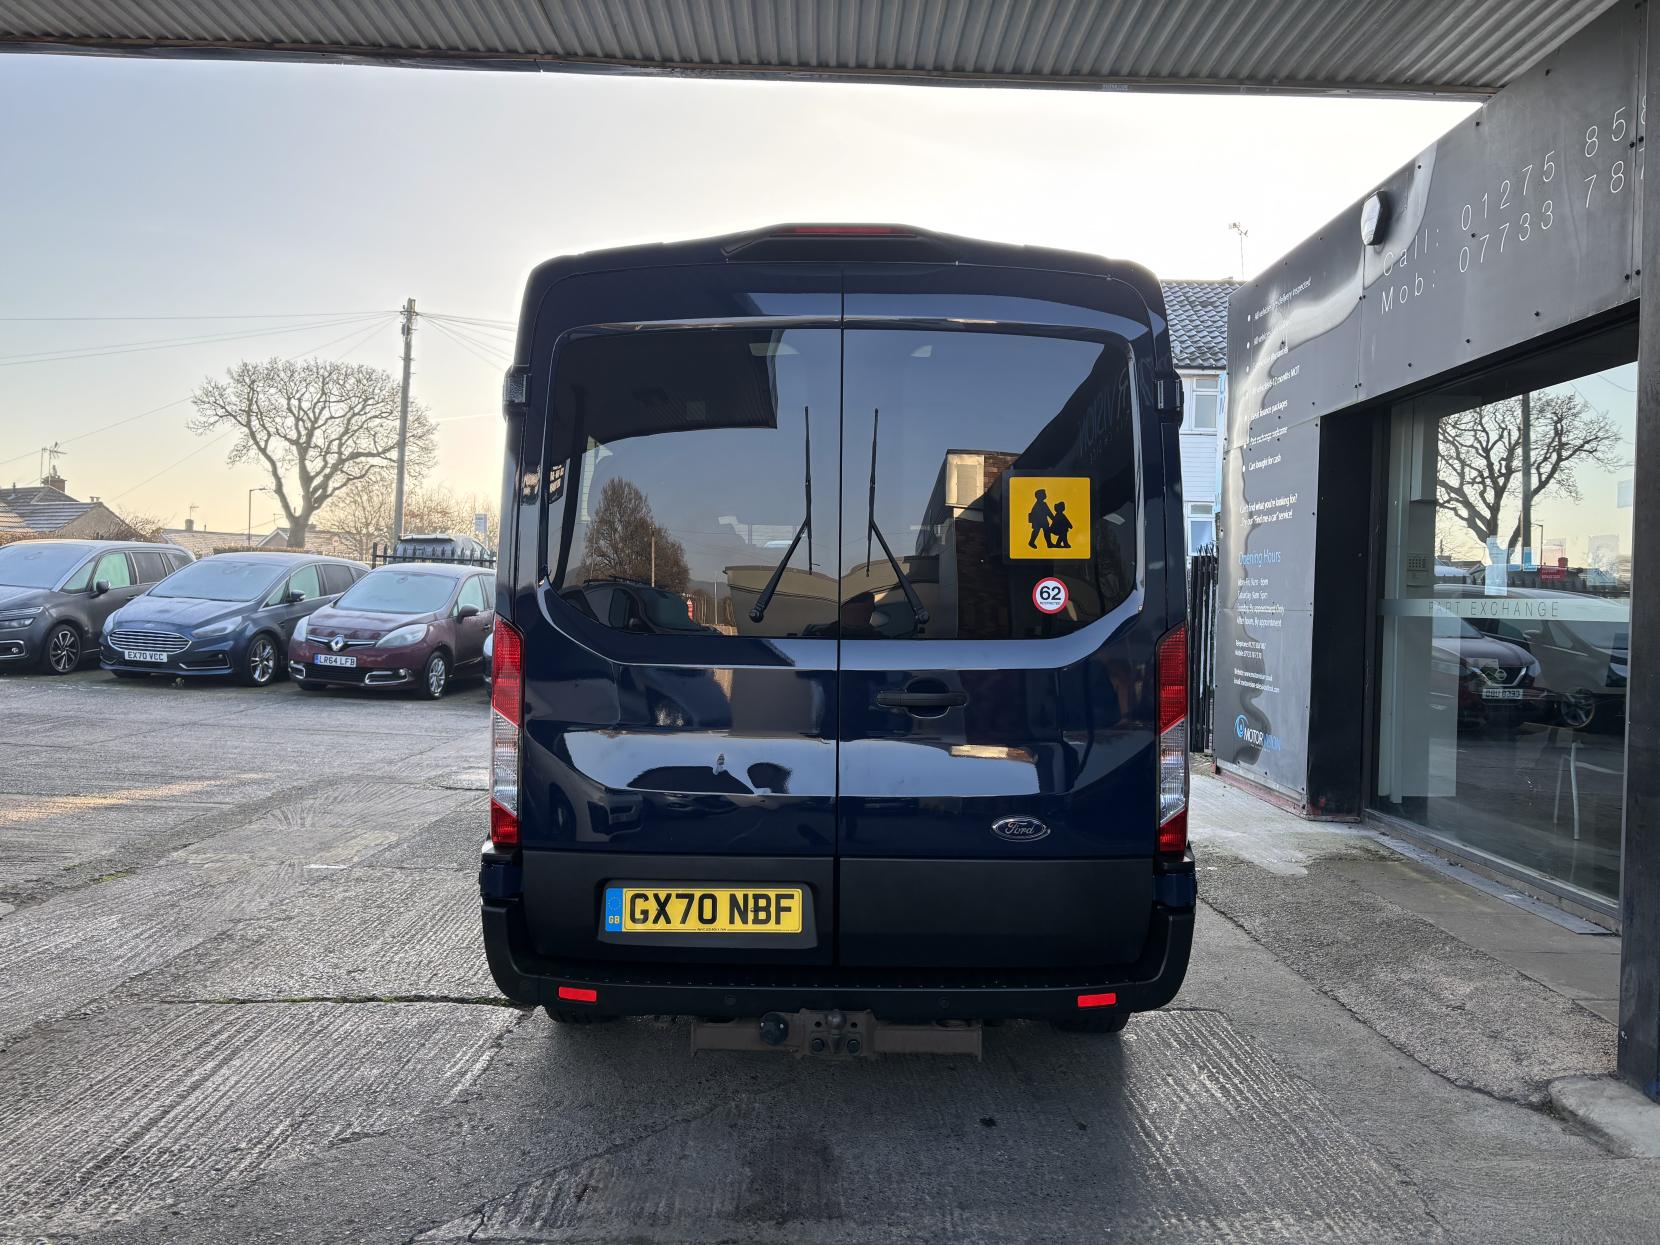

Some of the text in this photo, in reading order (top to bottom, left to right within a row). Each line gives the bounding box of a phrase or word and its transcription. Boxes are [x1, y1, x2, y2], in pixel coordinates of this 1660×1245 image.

[1383, 229, 1439, 276] Call:
[1461, 150, 1556, 231] 01275
[1381, 269, 1437, 315] Mob:
[1459, 200, 1554, 273] 07733
[1238, 548, 1281, 568] Opening Hours
[1040, 586, 1062, 601] 62
[1470, 601, 1560, 618] EXCHANGE
[127, 650, 164, 661] EX70 VCC
[319, 656, 338, 665] LR64
[1005, 821, 1035, 835] Ford
[629, 892, 795, 925] GX70 NBF
[608, 915, 620, 925] GB
